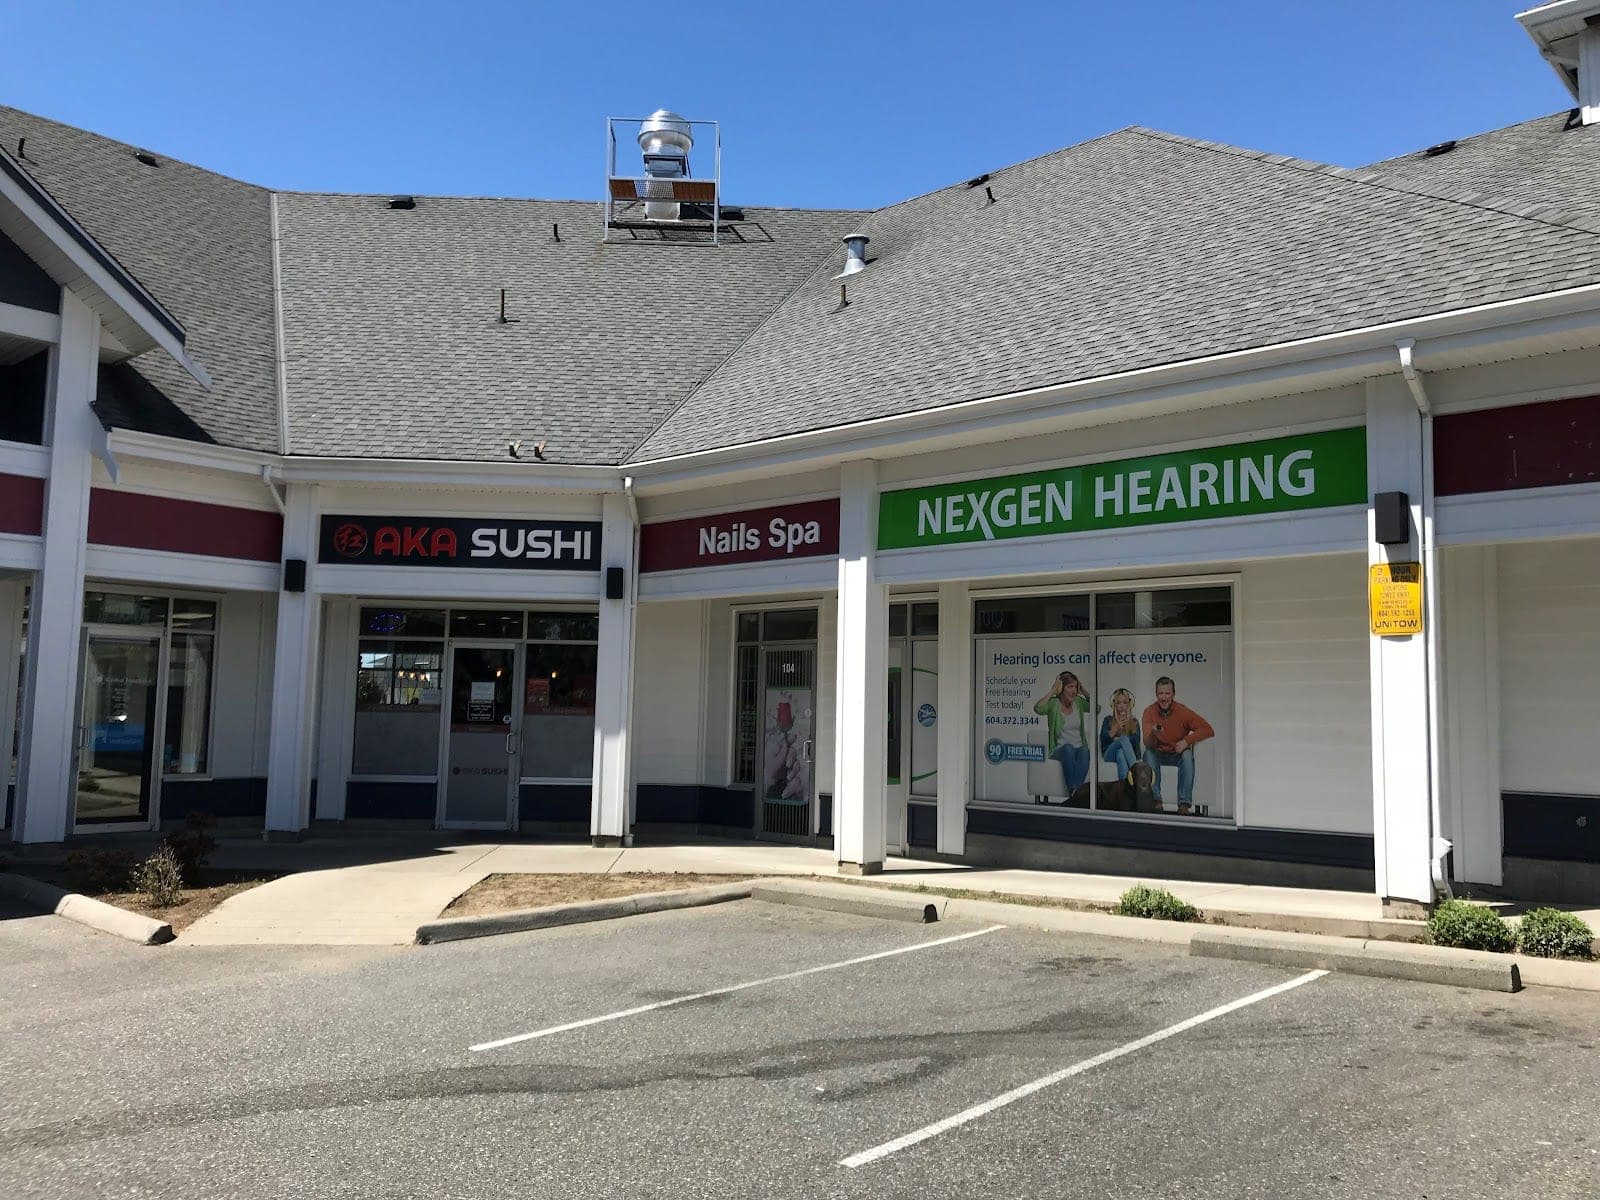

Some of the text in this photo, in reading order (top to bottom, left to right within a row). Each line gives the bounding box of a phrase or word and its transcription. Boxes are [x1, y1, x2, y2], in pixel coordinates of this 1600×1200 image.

[917, 450, 1316, 540] NEXGEN HEARING
[699, 518, 820, 555] Nails Spa
[373, 526, 592, 560] AKA SUSHI
[993, 650, 1207, 668] Hearing loss can affect everyone.
[781, 663, 795, 673] 104
[985, 676, 1036, 687] Schedule your
[986, 688, 1031, 698] Free Hearing
[985, 700, 1024, 711] Test today!
[985, 716, 1040, 725] 604.372.3344
[989, 744, 1001, 756] 90
[1007, 746, 1044, 756] FREE TRIAL
